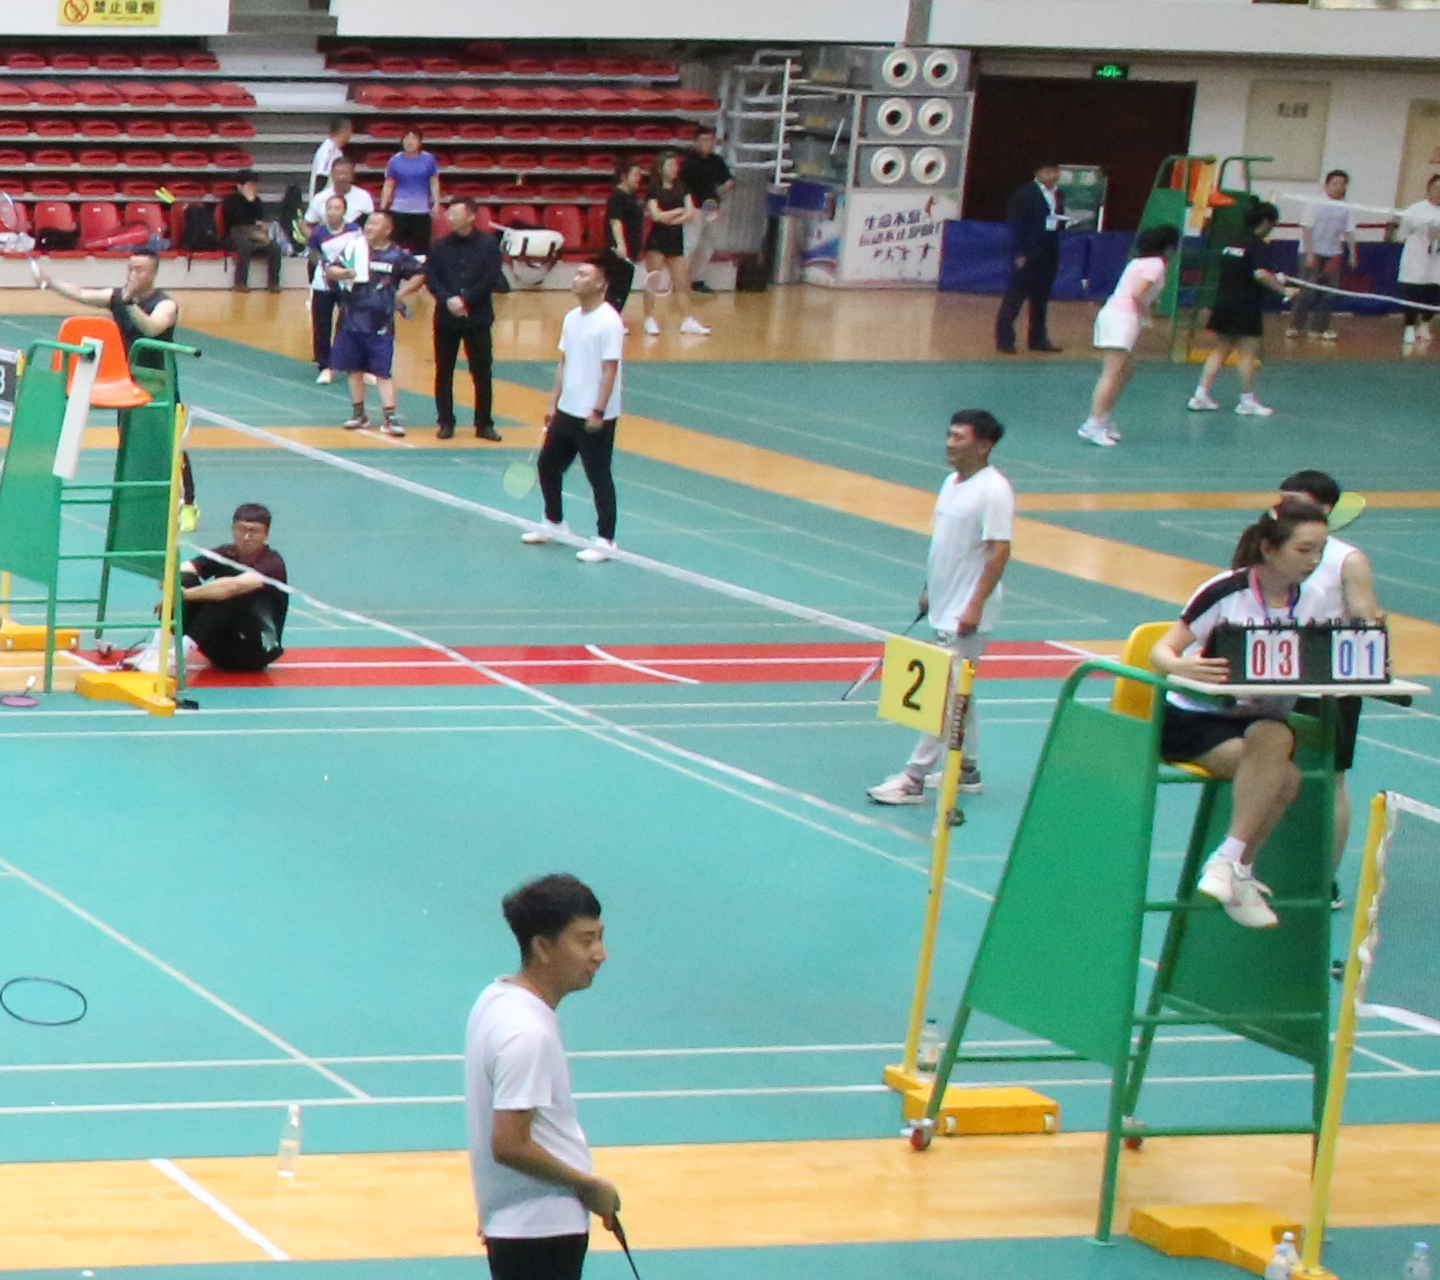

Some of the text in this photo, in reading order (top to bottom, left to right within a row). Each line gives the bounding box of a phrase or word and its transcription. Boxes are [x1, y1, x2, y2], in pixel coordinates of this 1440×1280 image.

[92, 0, 156, 15] 禁止吸烟
[1252, 639, 1295, 680] 03
[1338, 639, 1376, 678] 01
[903, 658, 926, 711] 2
